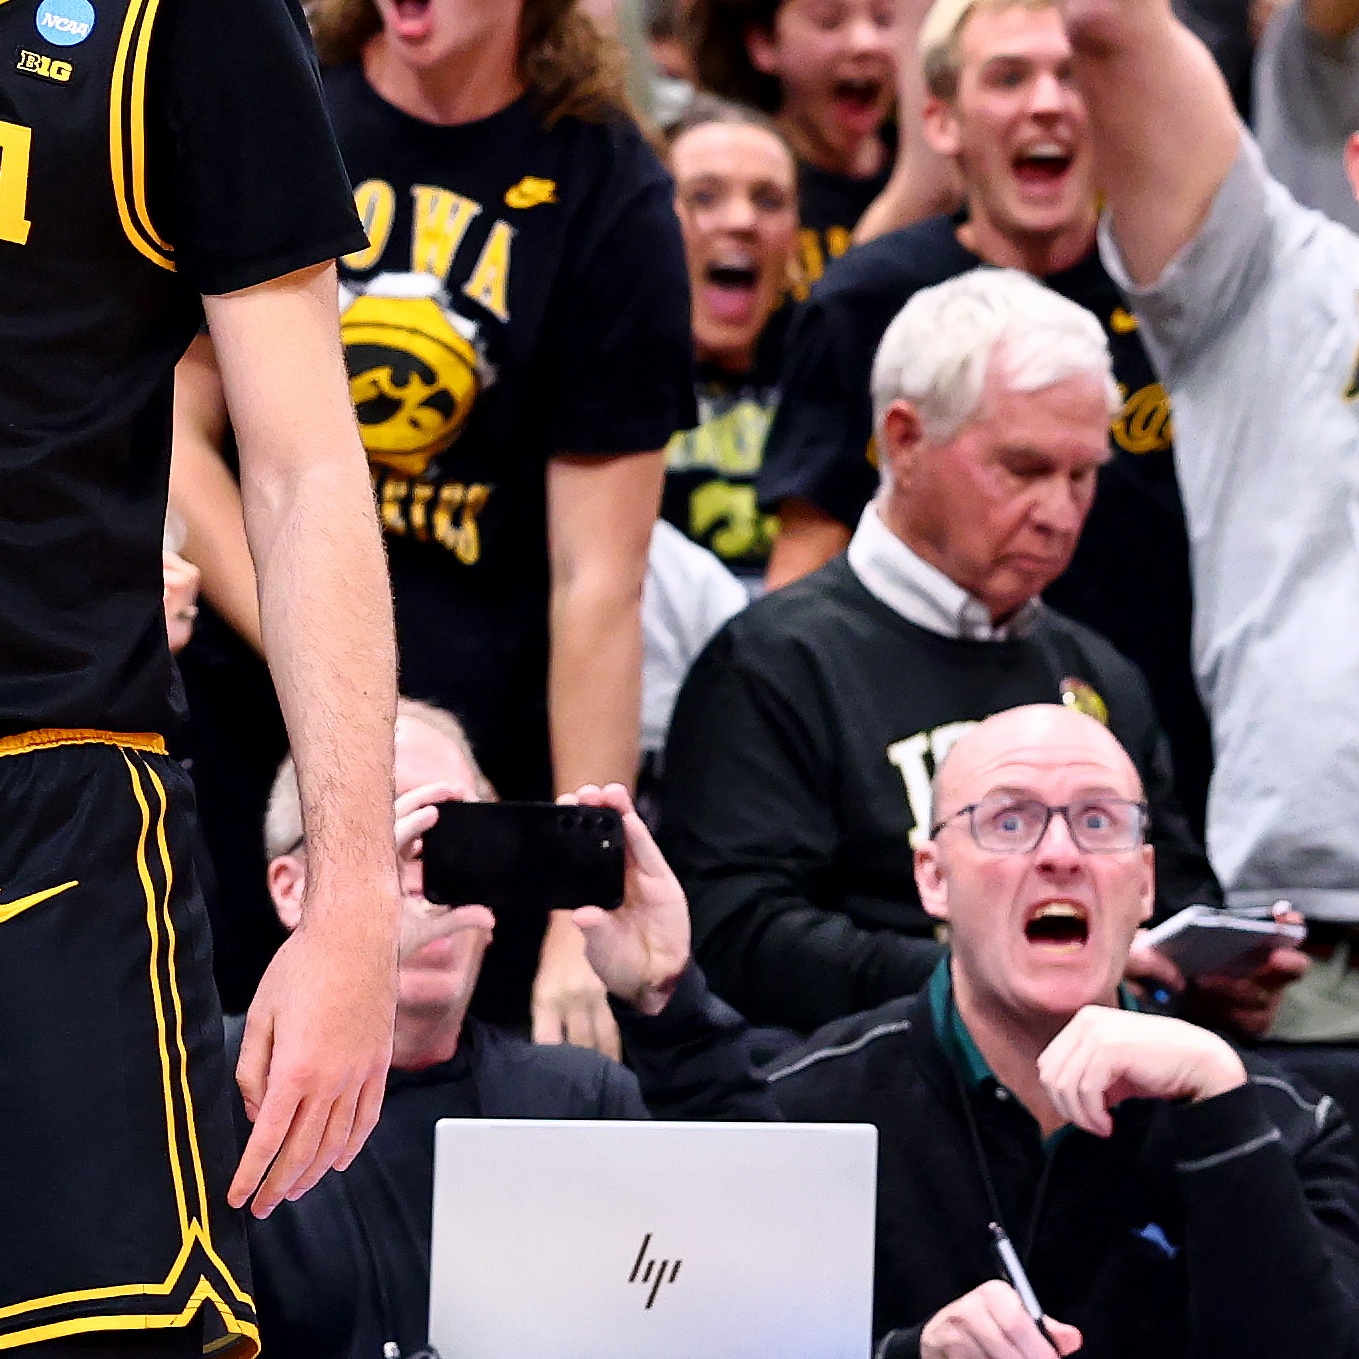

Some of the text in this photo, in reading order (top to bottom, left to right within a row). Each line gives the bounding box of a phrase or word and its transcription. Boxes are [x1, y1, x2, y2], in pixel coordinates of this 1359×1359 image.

[40, 12, 90, 37] NCAA
[338, 178, 520, 324] OWA
[627, 1233, 683, 1310] hp
